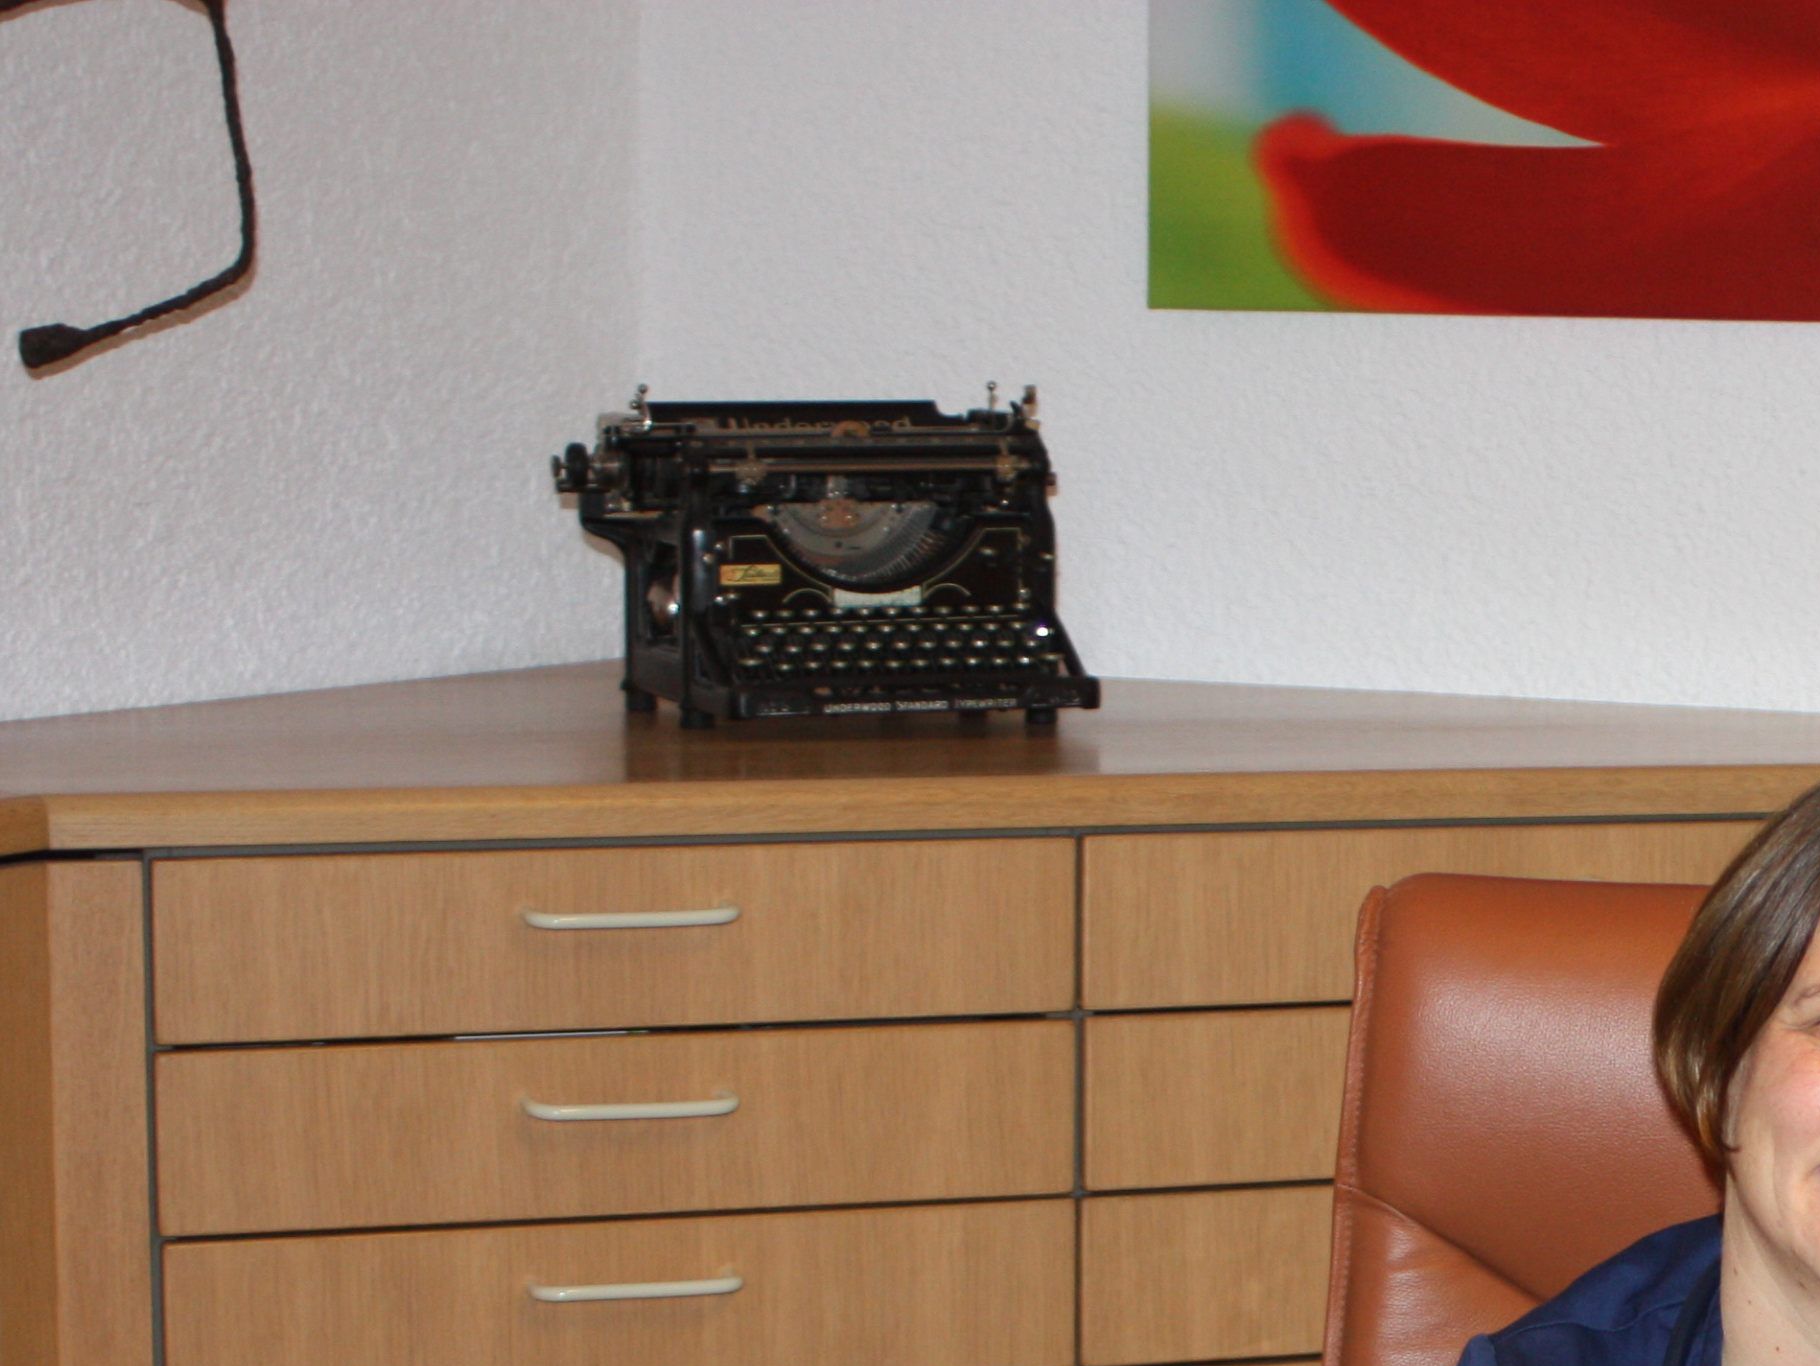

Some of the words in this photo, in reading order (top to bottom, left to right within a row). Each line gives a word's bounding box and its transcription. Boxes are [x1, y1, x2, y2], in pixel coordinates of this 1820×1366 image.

[823, 702, 891, 714] UNDERWOOD
[896, 700, 949, 711] STANDARD
[954, 698, 1017, 709] TYPEWRITER
